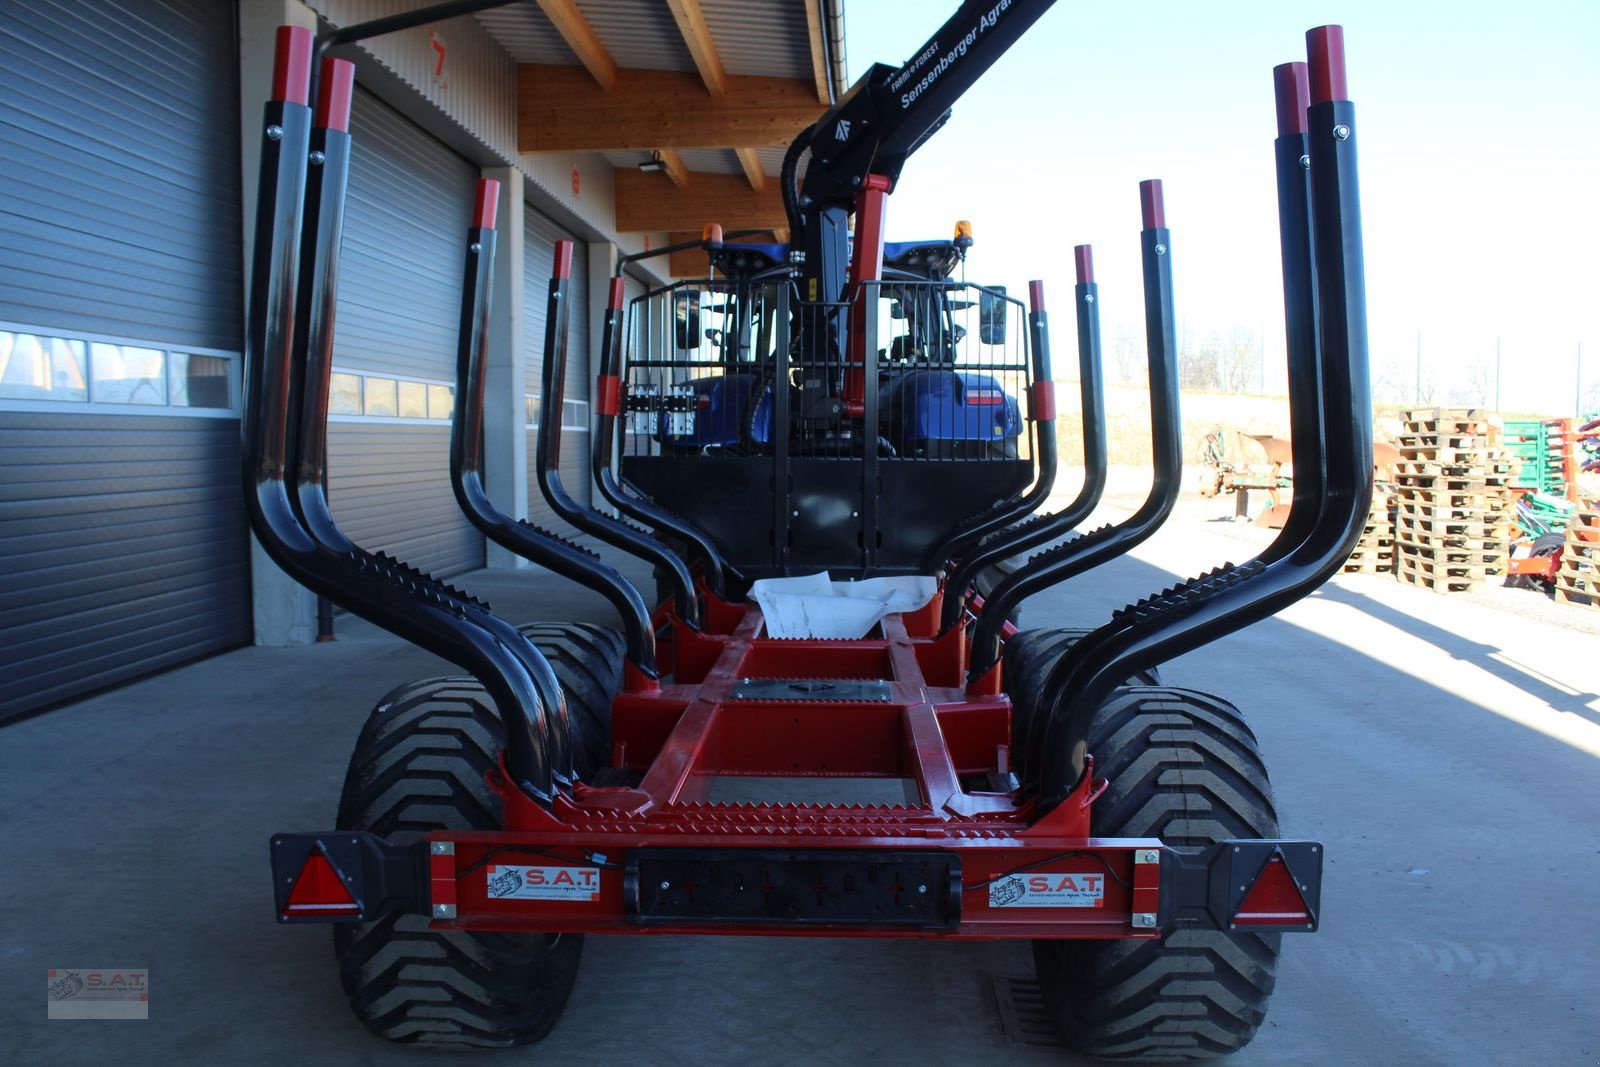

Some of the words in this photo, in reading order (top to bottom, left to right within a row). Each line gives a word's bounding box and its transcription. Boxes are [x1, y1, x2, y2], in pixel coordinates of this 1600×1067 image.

[915, 41, 939, 69] FOREST
[901, 27, 977, 109] Sensenberger
[525, 869, 597, 886] S.A.T.
[1028, 876, 1102, 892] S.A.T.
